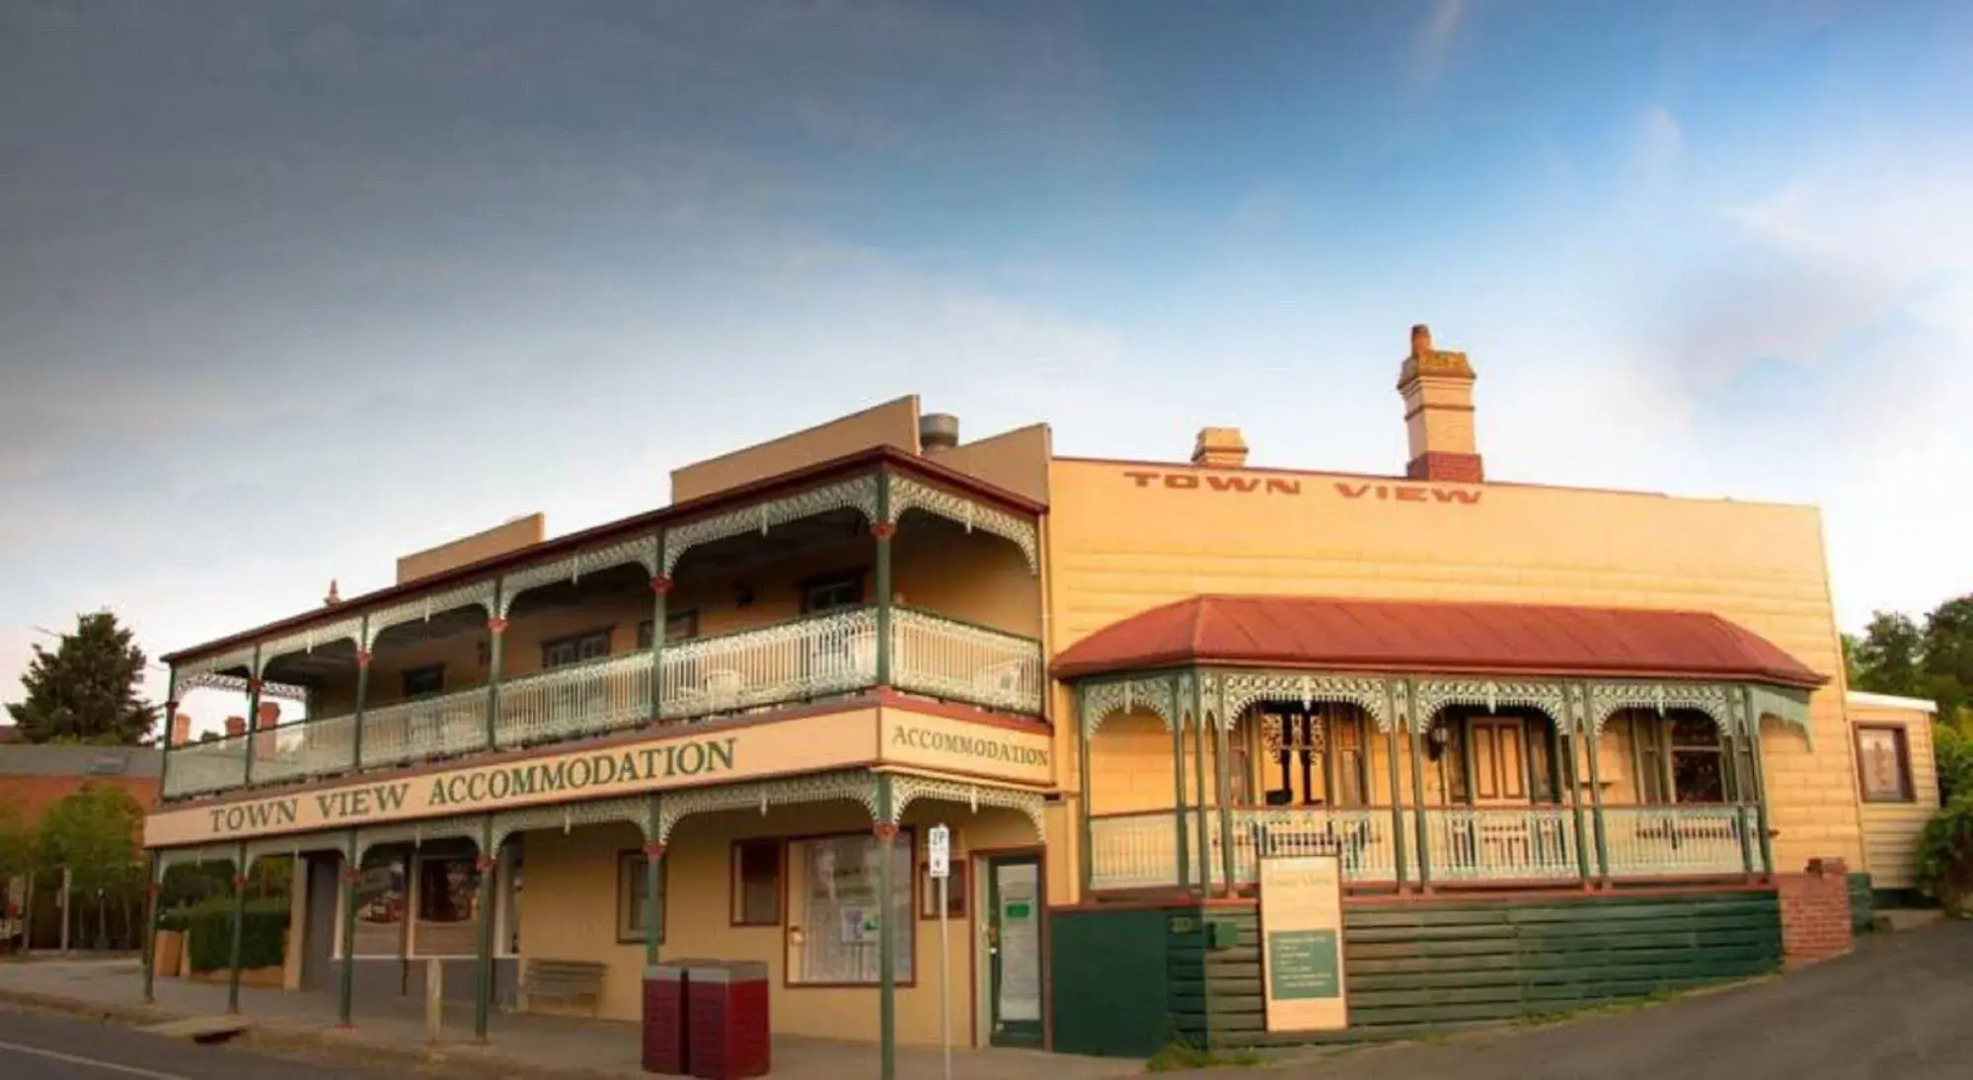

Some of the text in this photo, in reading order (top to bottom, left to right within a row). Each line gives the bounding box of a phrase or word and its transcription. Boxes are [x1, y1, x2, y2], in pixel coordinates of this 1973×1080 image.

[1123, 471, 1483, 504] TOWN VIEW
[892, 725, 1049, 767] ACCOMMODATION
[210, 738, 738, 833] TOWN VIEW ACCOMMODATION
